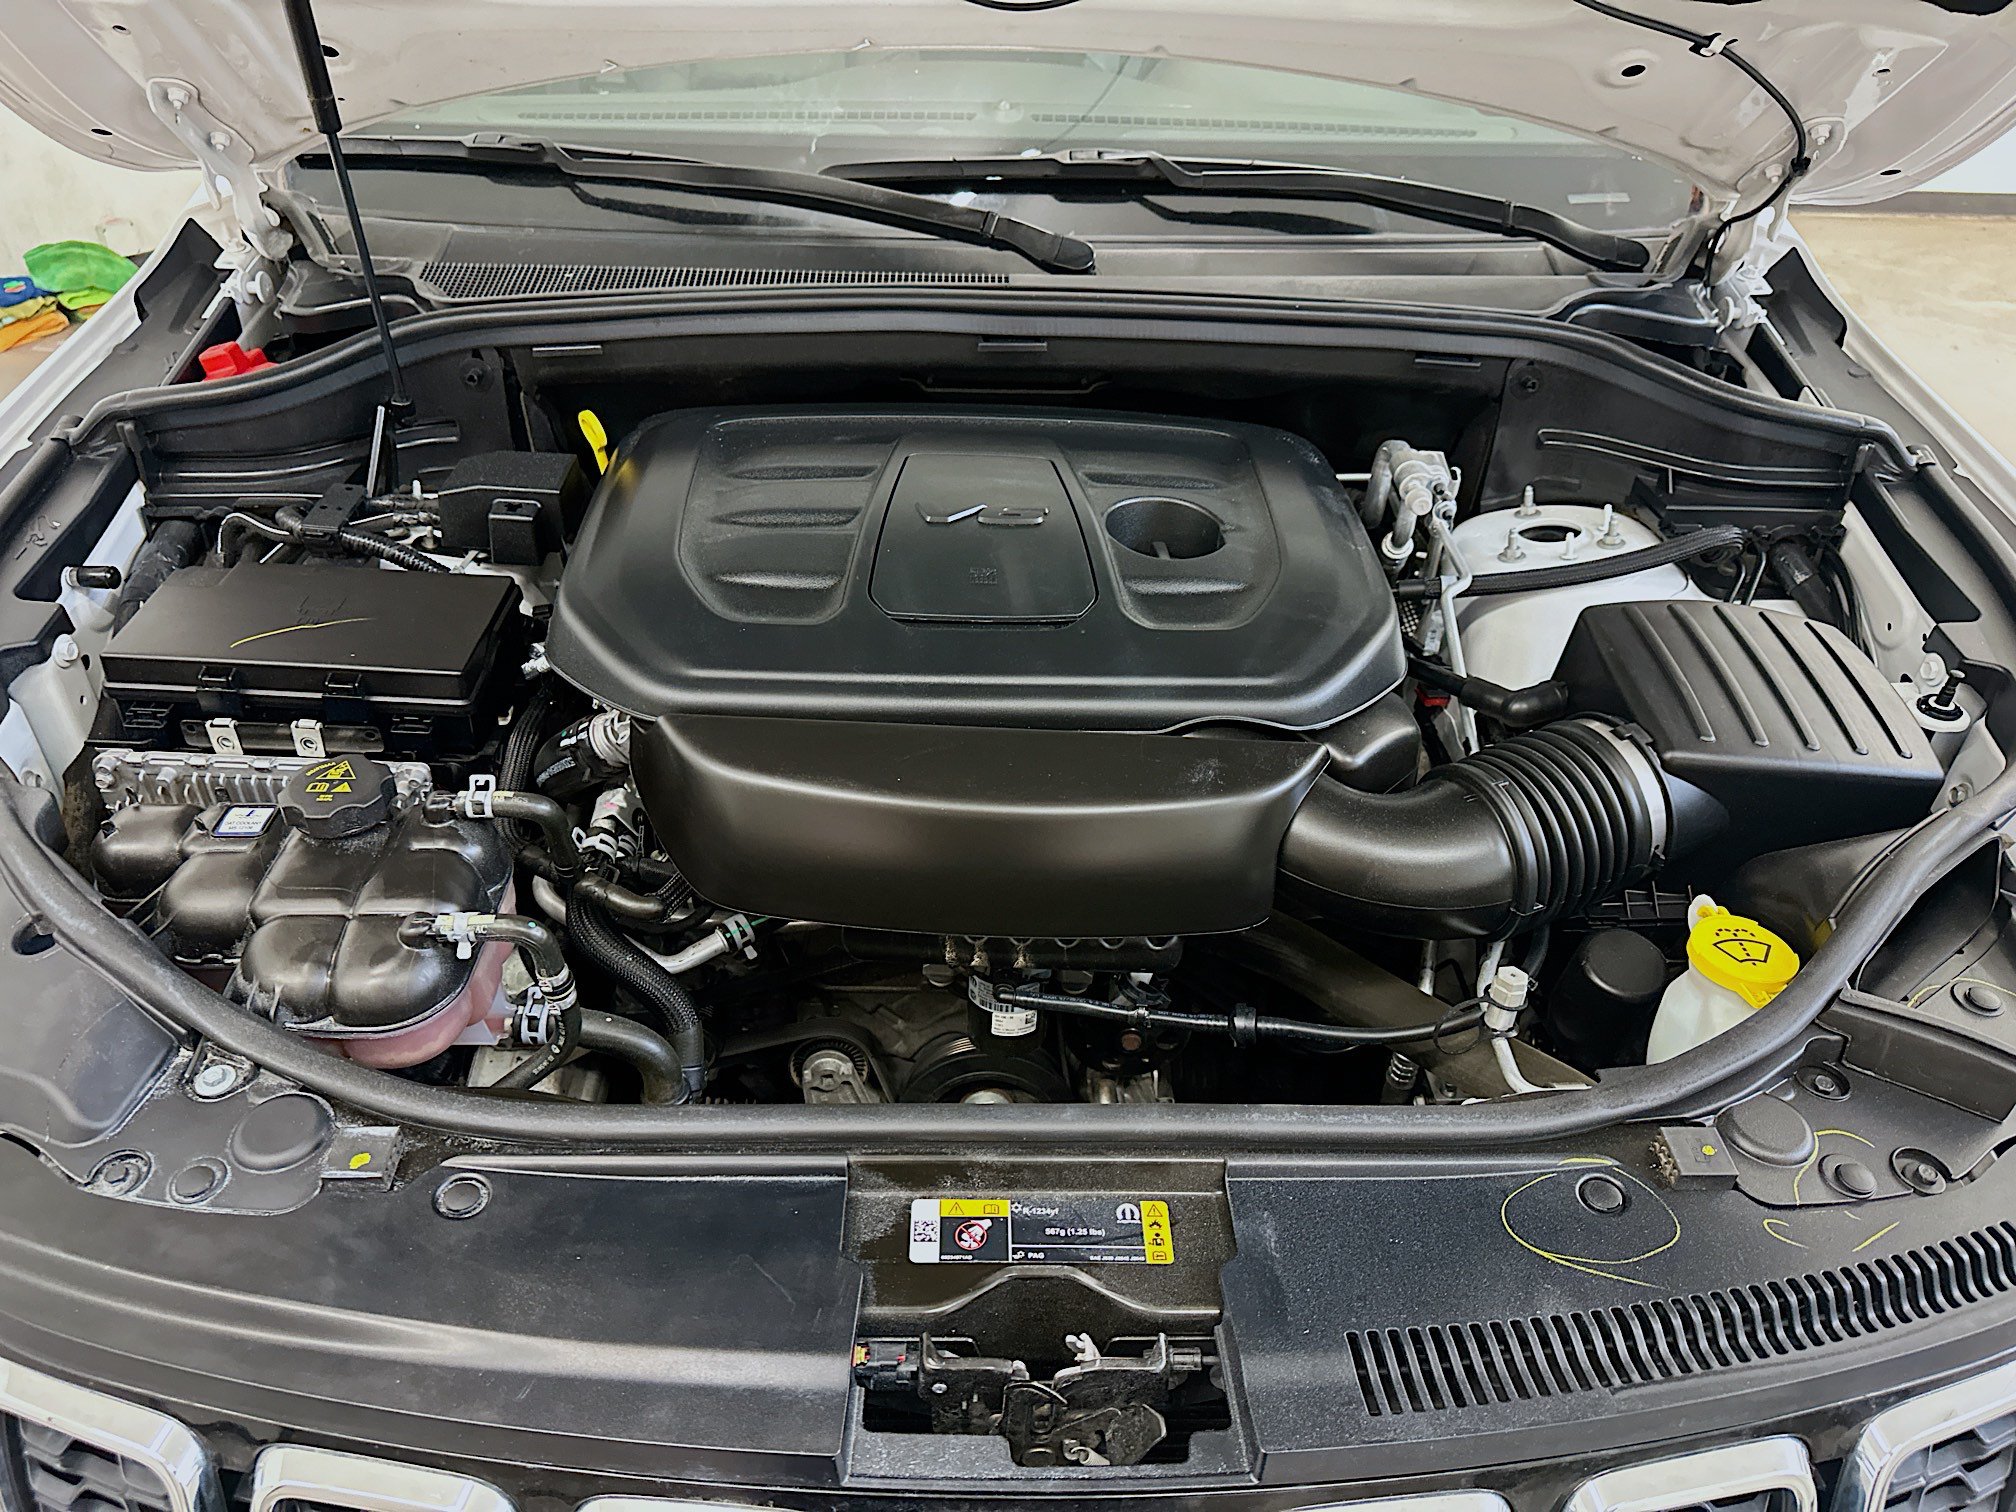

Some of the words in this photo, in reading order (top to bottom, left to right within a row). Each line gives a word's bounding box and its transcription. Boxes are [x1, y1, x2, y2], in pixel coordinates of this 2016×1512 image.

[1045, 1227, 1066, 1237] 567g
[1067, 1227, 1088, 1237] (1.25
[1089, 1227, 1106, 1237] lbs)
